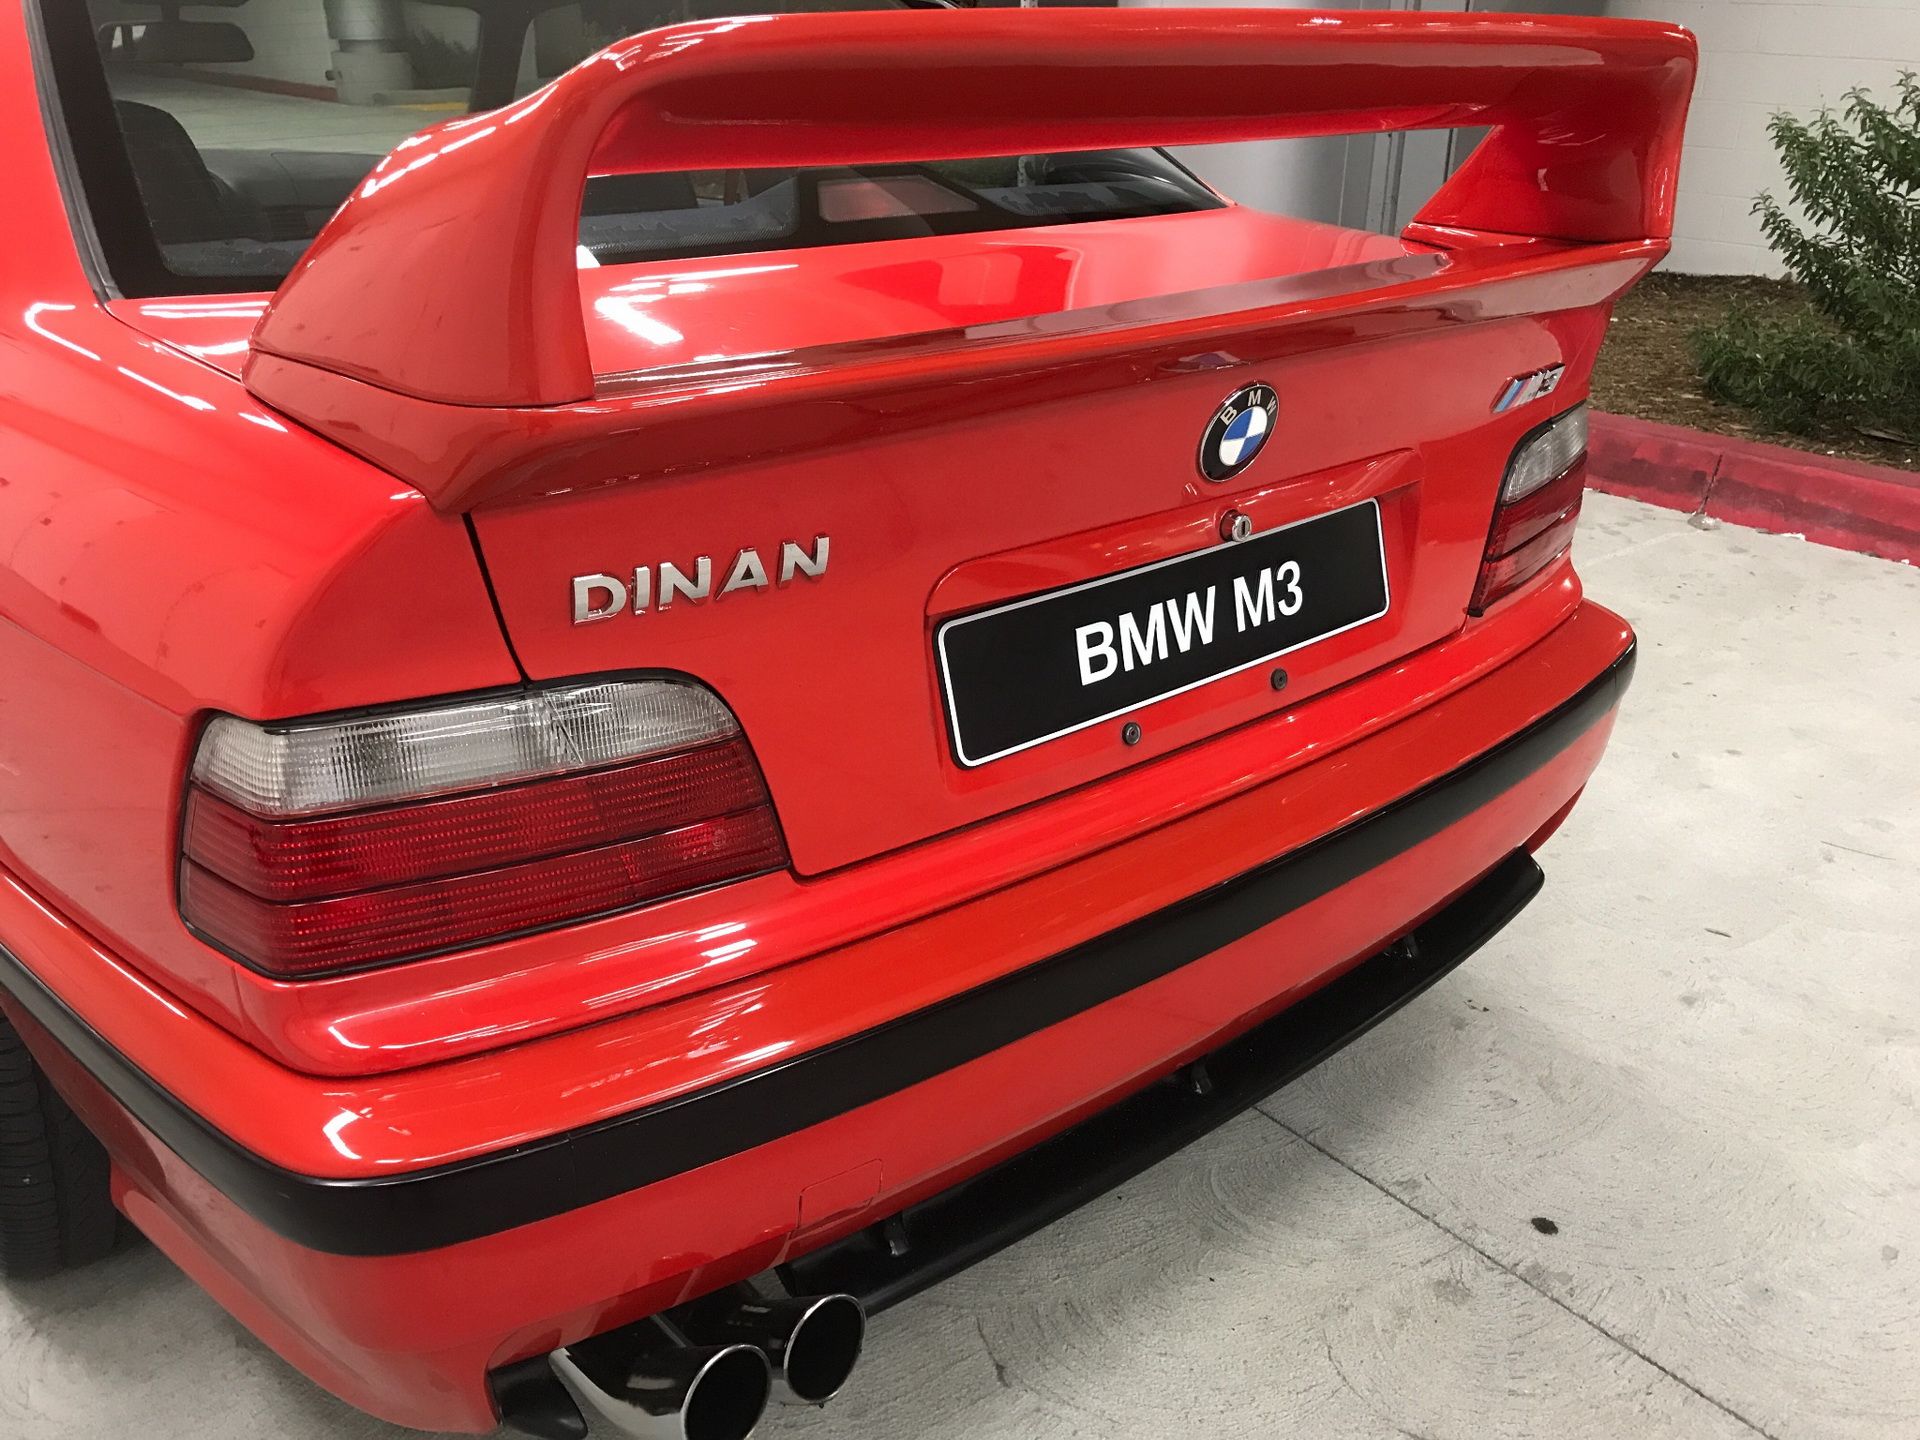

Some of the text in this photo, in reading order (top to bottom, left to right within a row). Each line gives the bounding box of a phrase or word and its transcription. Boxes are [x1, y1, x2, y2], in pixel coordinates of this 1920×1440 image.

[1220, 389, 1277, 426] BMW
[572, 535, 831, 625] DINAN
[1075, 560, 1304, 687] BMW M3
